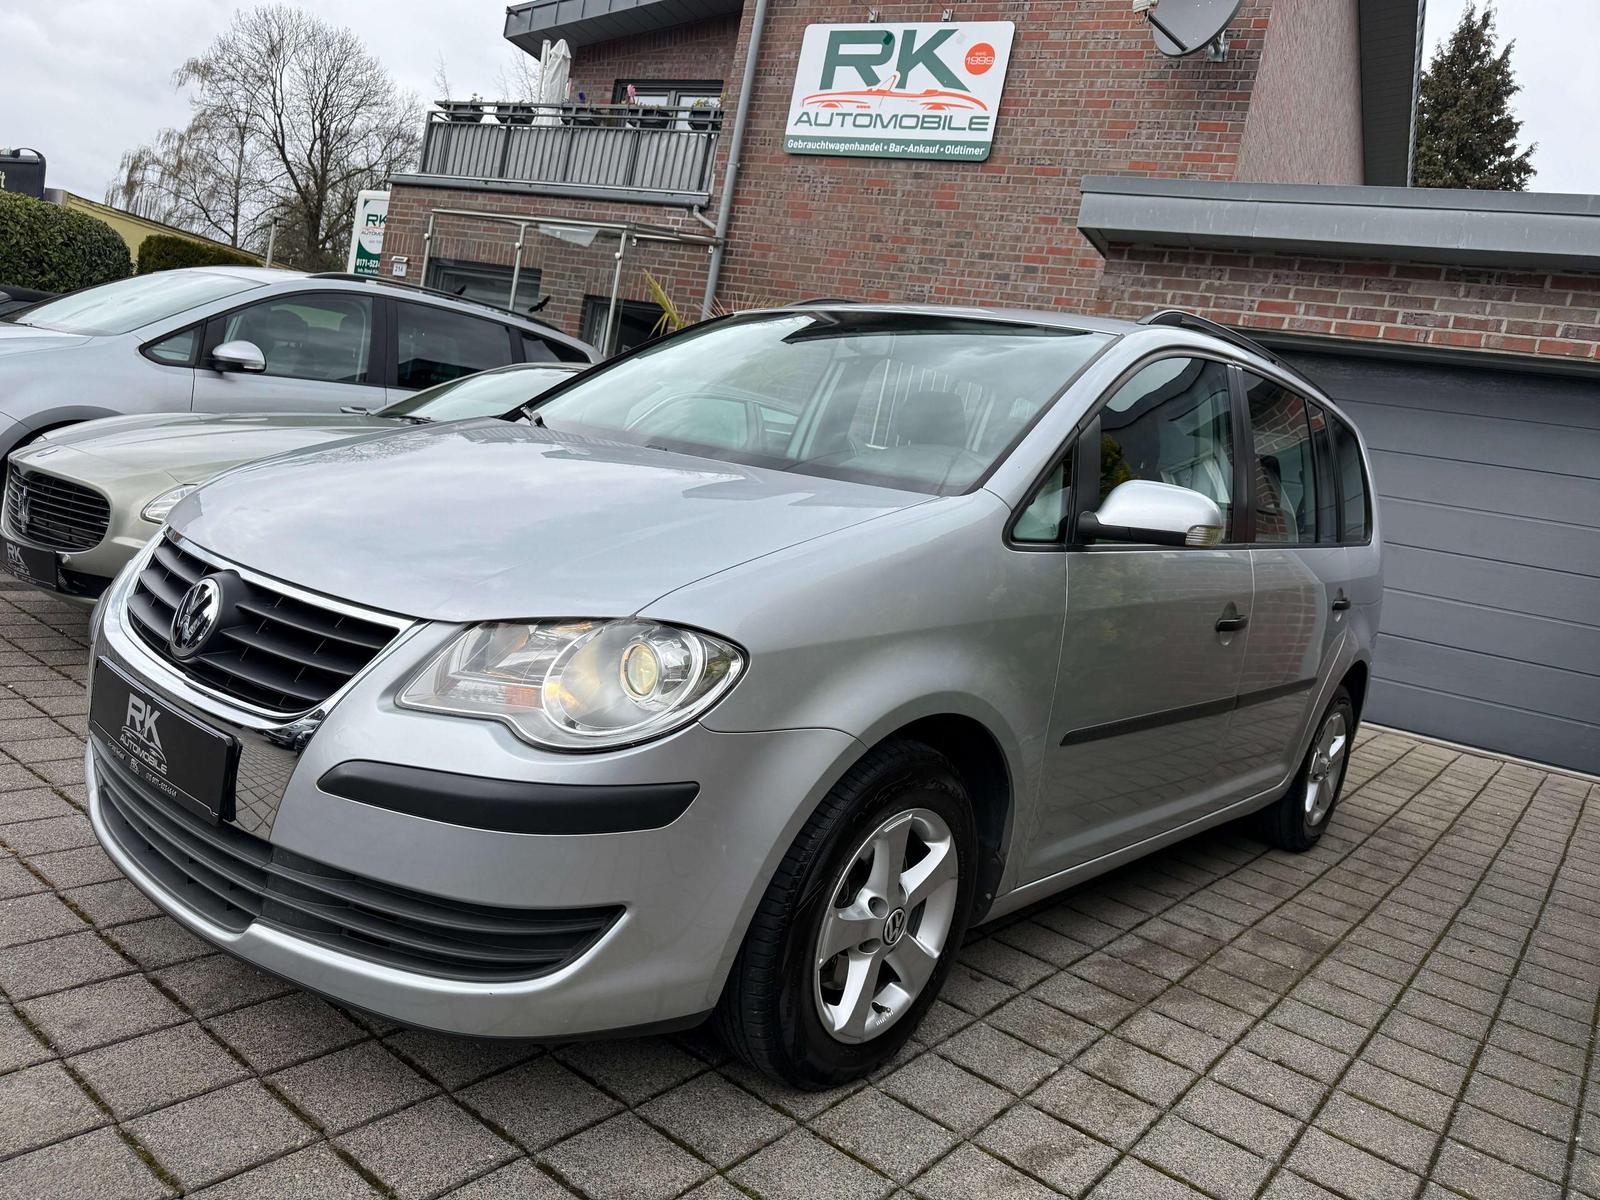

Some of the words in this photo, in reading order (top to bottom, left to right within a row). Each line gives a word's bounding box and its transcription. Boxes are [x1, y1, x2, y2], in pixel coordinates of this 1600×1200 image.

[819, 28, 971, 93] RK
[966, 56, 995, 65] 1999
[794, 111, 990, 131] AUTOMOBILE
[787, 139, 883, 153] Gebrauchtwagenhandel
[889, 143, 940, 155] Bar-Ankauf
[945, 145, 985, 156] Oldtimer
[366, 214, 387, 227] RK
[126, 692, 163, 752] RK
[120, 733, 168, 775] AUTOMOBILE
